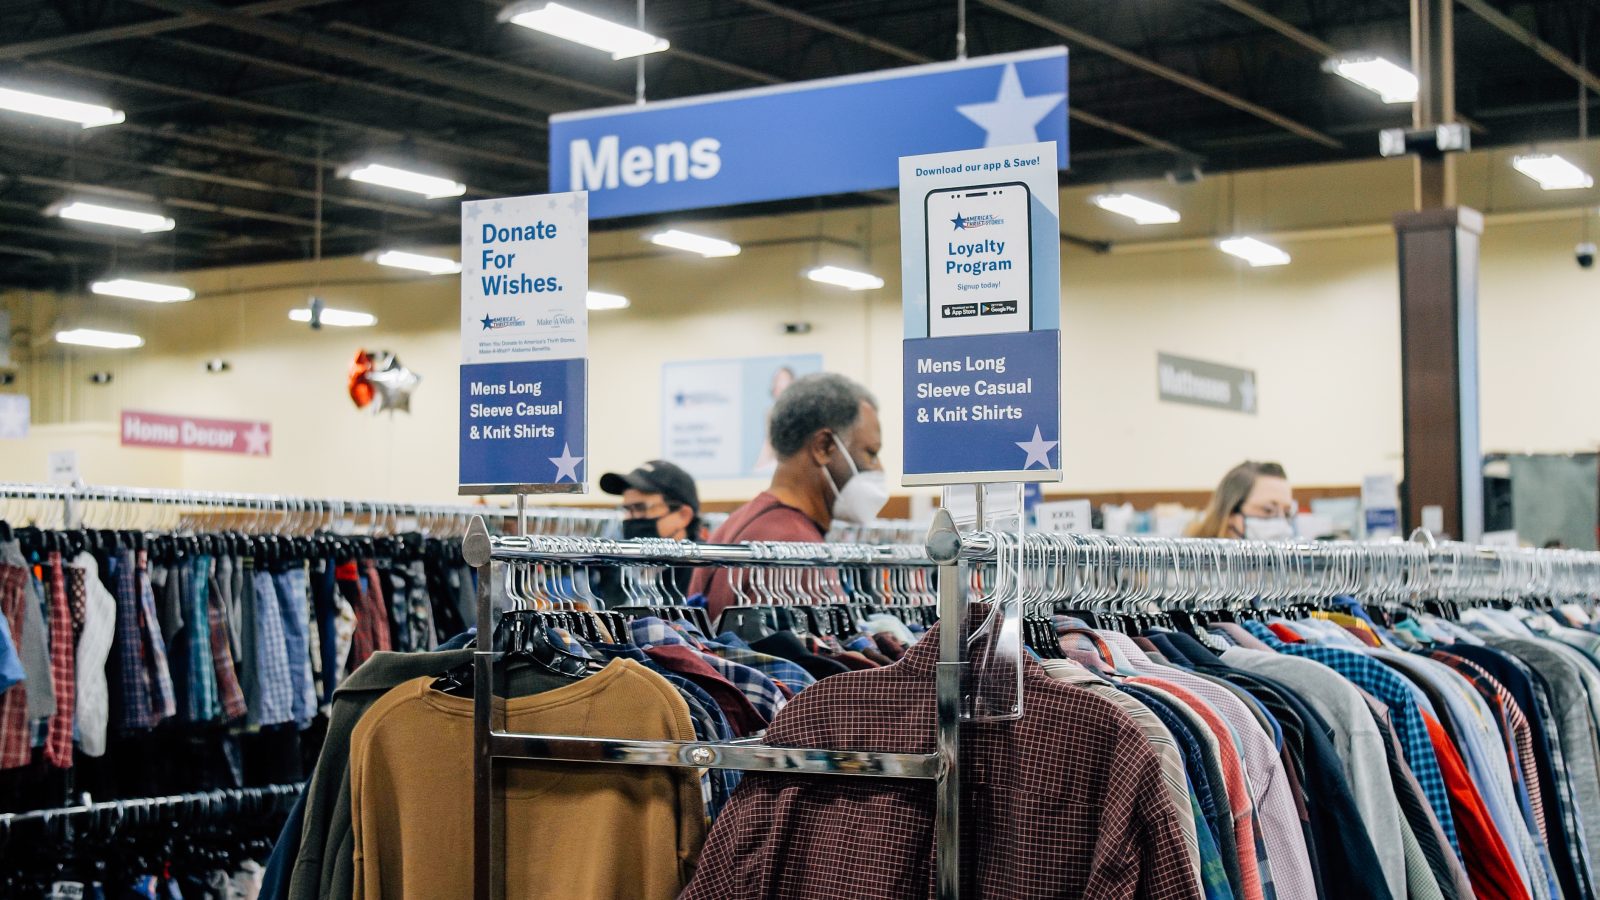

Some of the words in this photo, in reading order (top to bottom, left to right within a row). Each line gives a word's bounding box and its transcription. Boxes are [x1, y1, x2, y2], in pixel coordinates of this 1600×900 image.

[569, 135, 722, 192] Mens
[915, 164, 963, 177] Download
[965, 164, 982, 172] our
[983, 162, 1001, 172] app
[1003, 159, 1011, 168] &
[1013, 156, 1040, 167] Save!
[482, 220, 557, 244] Donate
[948, 239, 1005, 258] Loyalty
[482, 249, 515, 270] For
[946, 259, 1012, 276] Program
[481, 273, 563, 296] Wishes.
[957, 283, 980, 291] Signup
[980, 281, 1001, 289] today!
[917, 358, 961, 374] Mens
[965, 356, 1006, 374] Long
[470, 381, 506, 396] Mens
[509, 380, 542, 397] Long
[917, 382, 970, 399] Sleeve
[974, 378, 1032, 396] Casual
[470, 403, 513, 418] Sleeve
[516, 400, 563, 416] Casual
[916, 407, 930, 423] &
[933, 406, 968, 422] Knit
[971, 404, 1023, 421] Shirts
[124, 416, 179, 443] Home
[181, 420, 237, 448] Decor
[469, 425, 480, 440] &
[483, 425, 511, 439] Knit
[513, 424, 555, 439] Shirts
